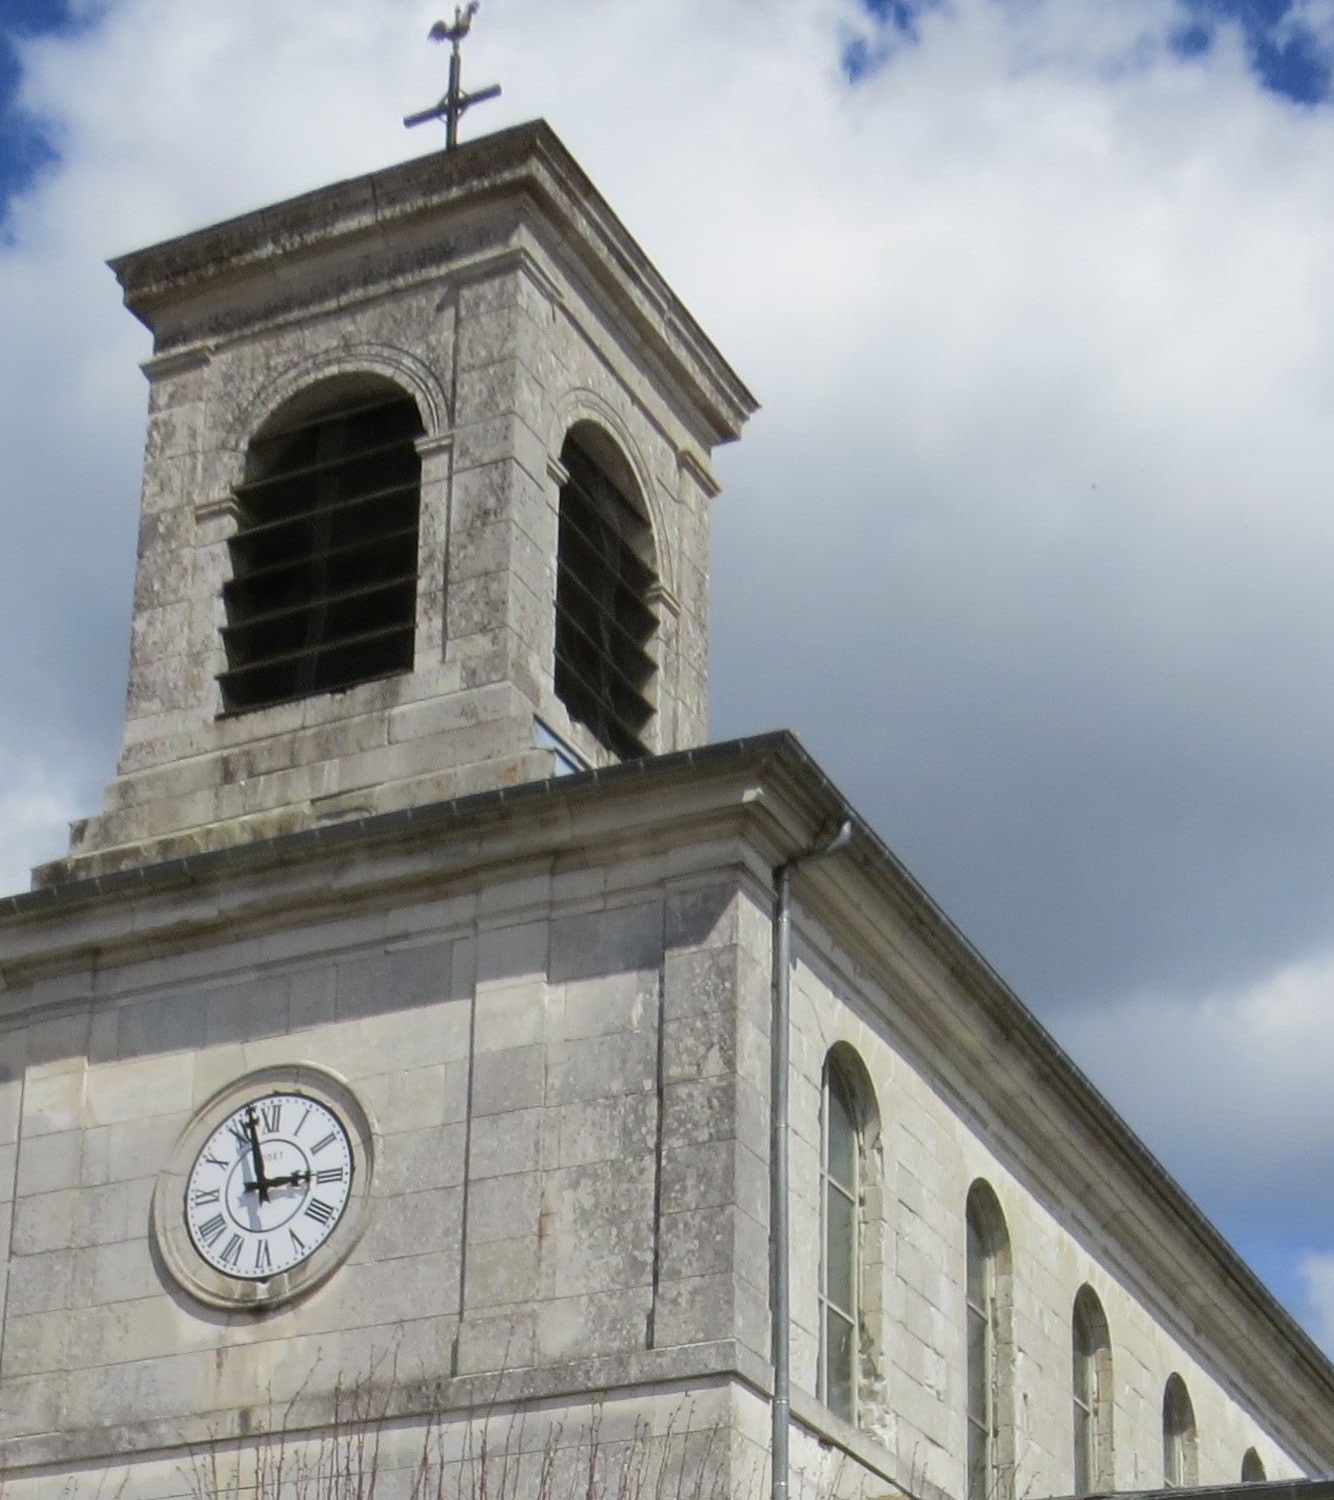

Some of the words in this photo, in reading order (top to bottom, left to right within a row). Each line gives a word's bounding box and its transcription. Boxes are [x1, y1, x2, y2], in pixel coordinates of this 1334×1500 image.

[260, 1104, 282, 1135] XII
[294, 1108, 310, 1137] I
[310, 1131, 337, 1156] II
[205, 1153, 229, 1172] X
[316, 1167, 343, 1185] III
[195, 1188, 220, 1207] IX
[305, 1196, 335, 1226] IIII
[198, 1212, 228, 1248] VIII
[289, 1228, 305, 1255] V
[219, 1233, 245, 1266] VII
[255, 1239, 272, 1269] VI
